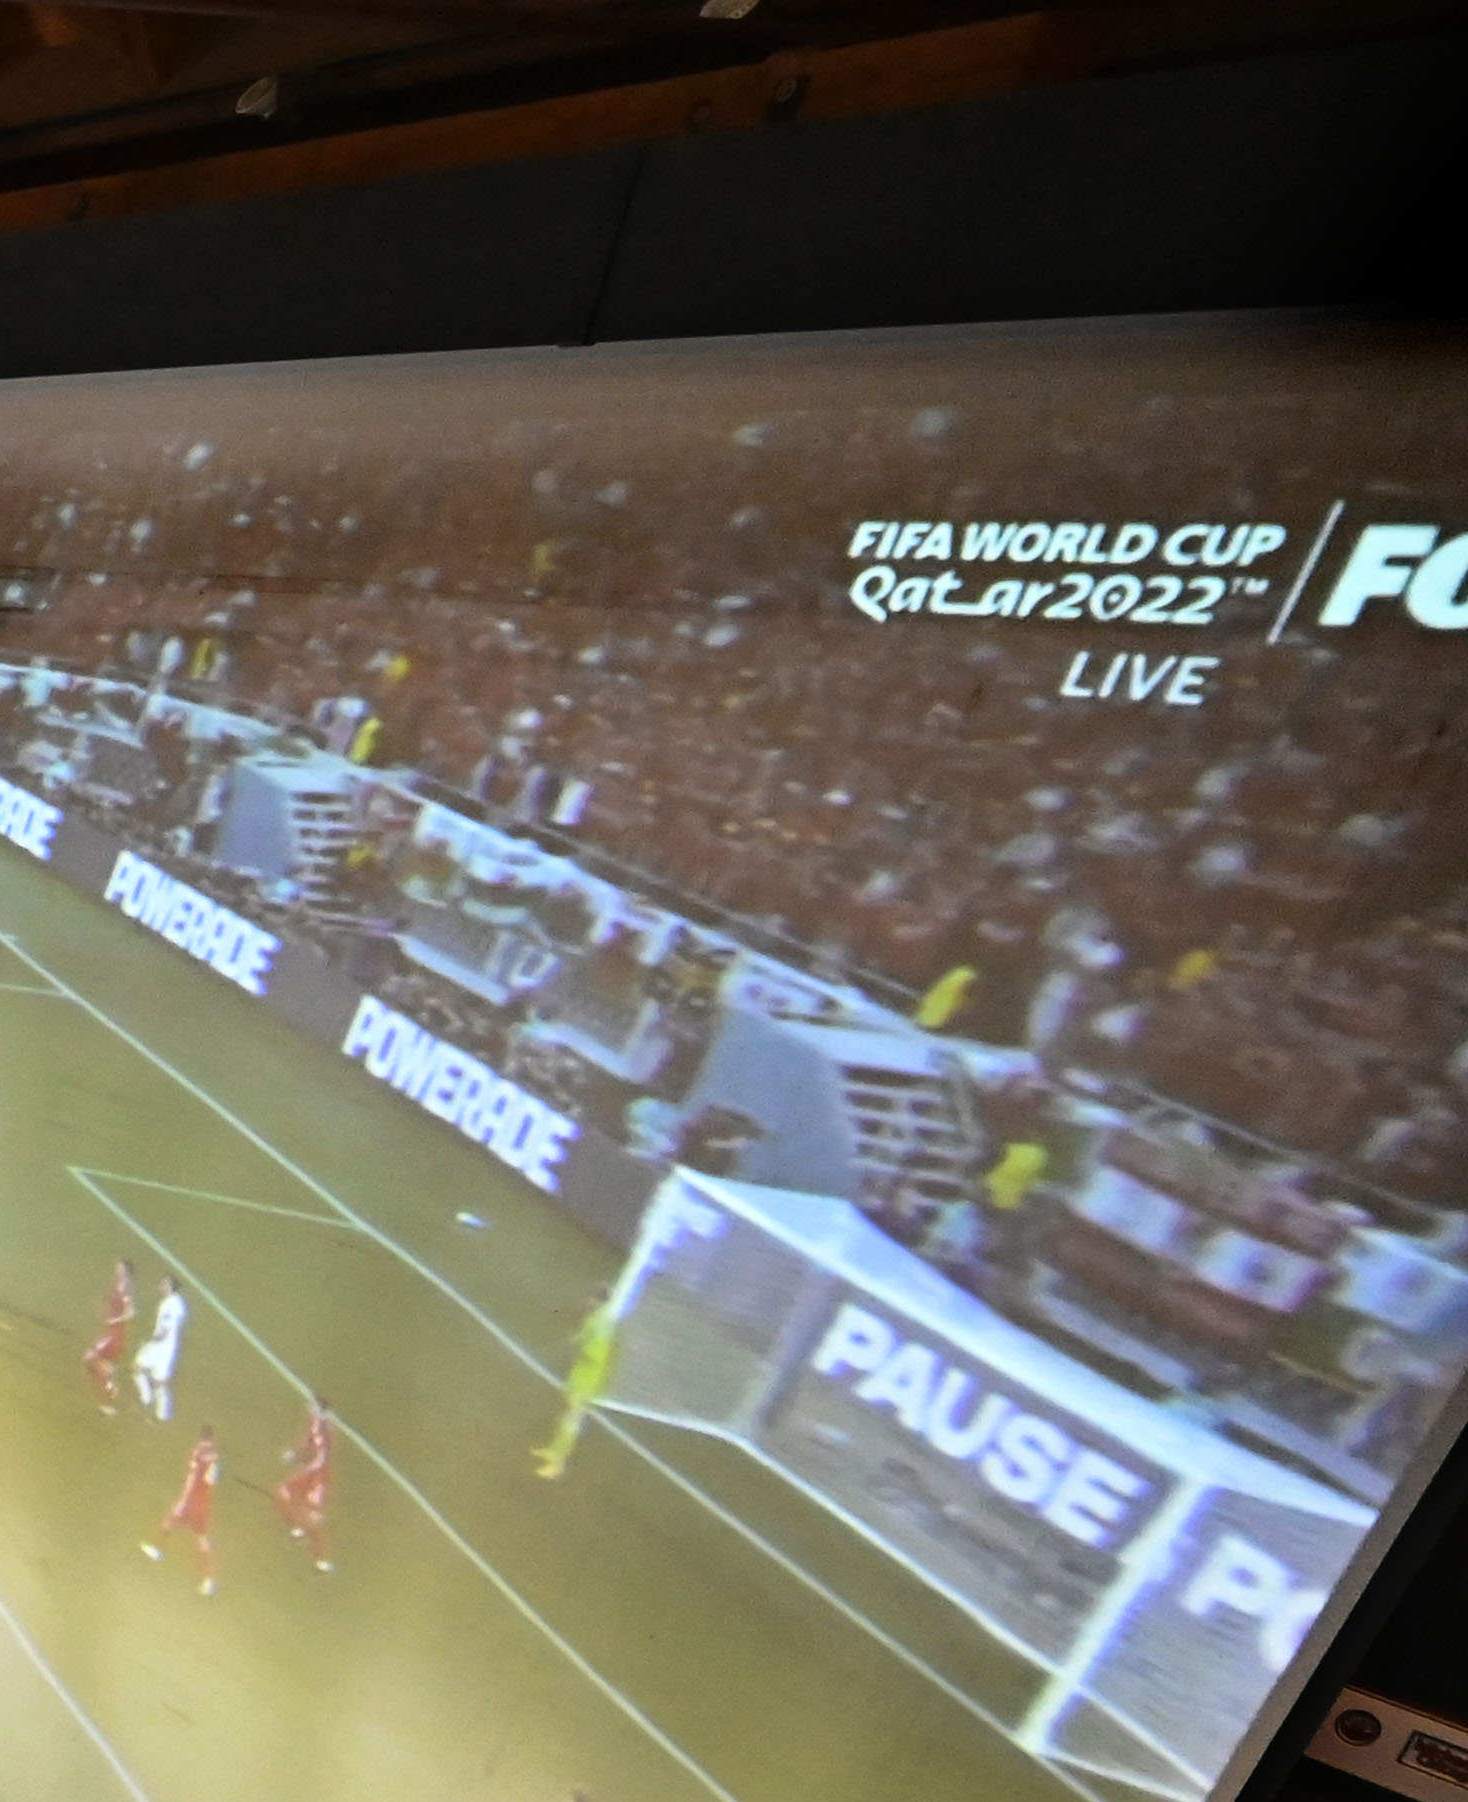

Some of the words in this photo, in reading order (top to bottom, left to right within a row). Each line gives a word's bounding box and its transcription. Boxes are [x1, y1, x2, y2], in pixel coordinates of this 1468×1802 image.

[847, 520, 954, 560] FIFA
[960, 521, 1160, 564] WORLD
[1163, 522, 1288, 567] CUP
[1058, 650, 1222, 706] LIVE
[102, 848, 284, 997] POWERADE
[340, 992, 582, 1194] POWERADE
[812, 1303, 1150, 1549] PAUSE
